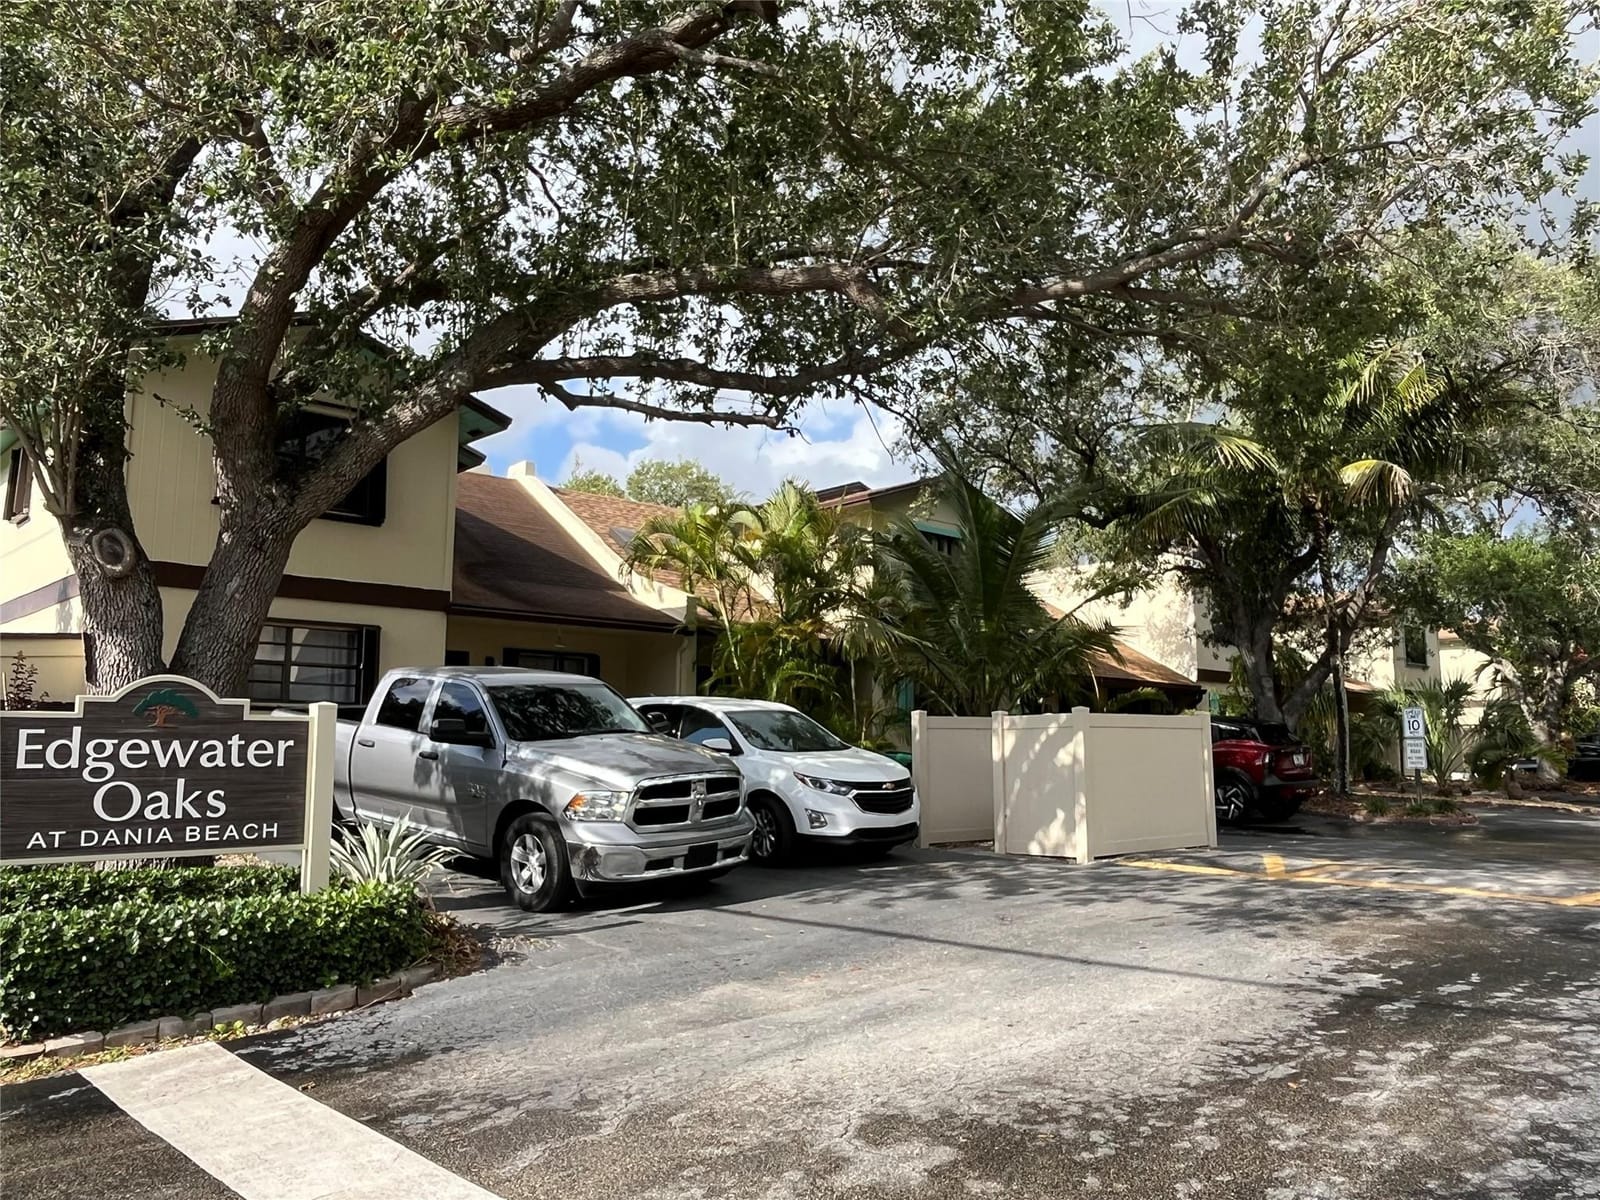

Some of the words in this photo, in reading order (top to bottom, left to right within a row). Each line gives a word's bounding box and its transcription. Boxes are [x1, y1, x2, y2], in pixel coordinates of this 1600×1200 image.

[1407, 719, 1420, 731] 10
[16, 726, 295, 783] Edgewater
[93, 778, 227, 822] Oaks
[26, 830, 67, 849] AT
[80, 827, 174, 847] DANIA
[185, 822, 279, 842] BEACH
